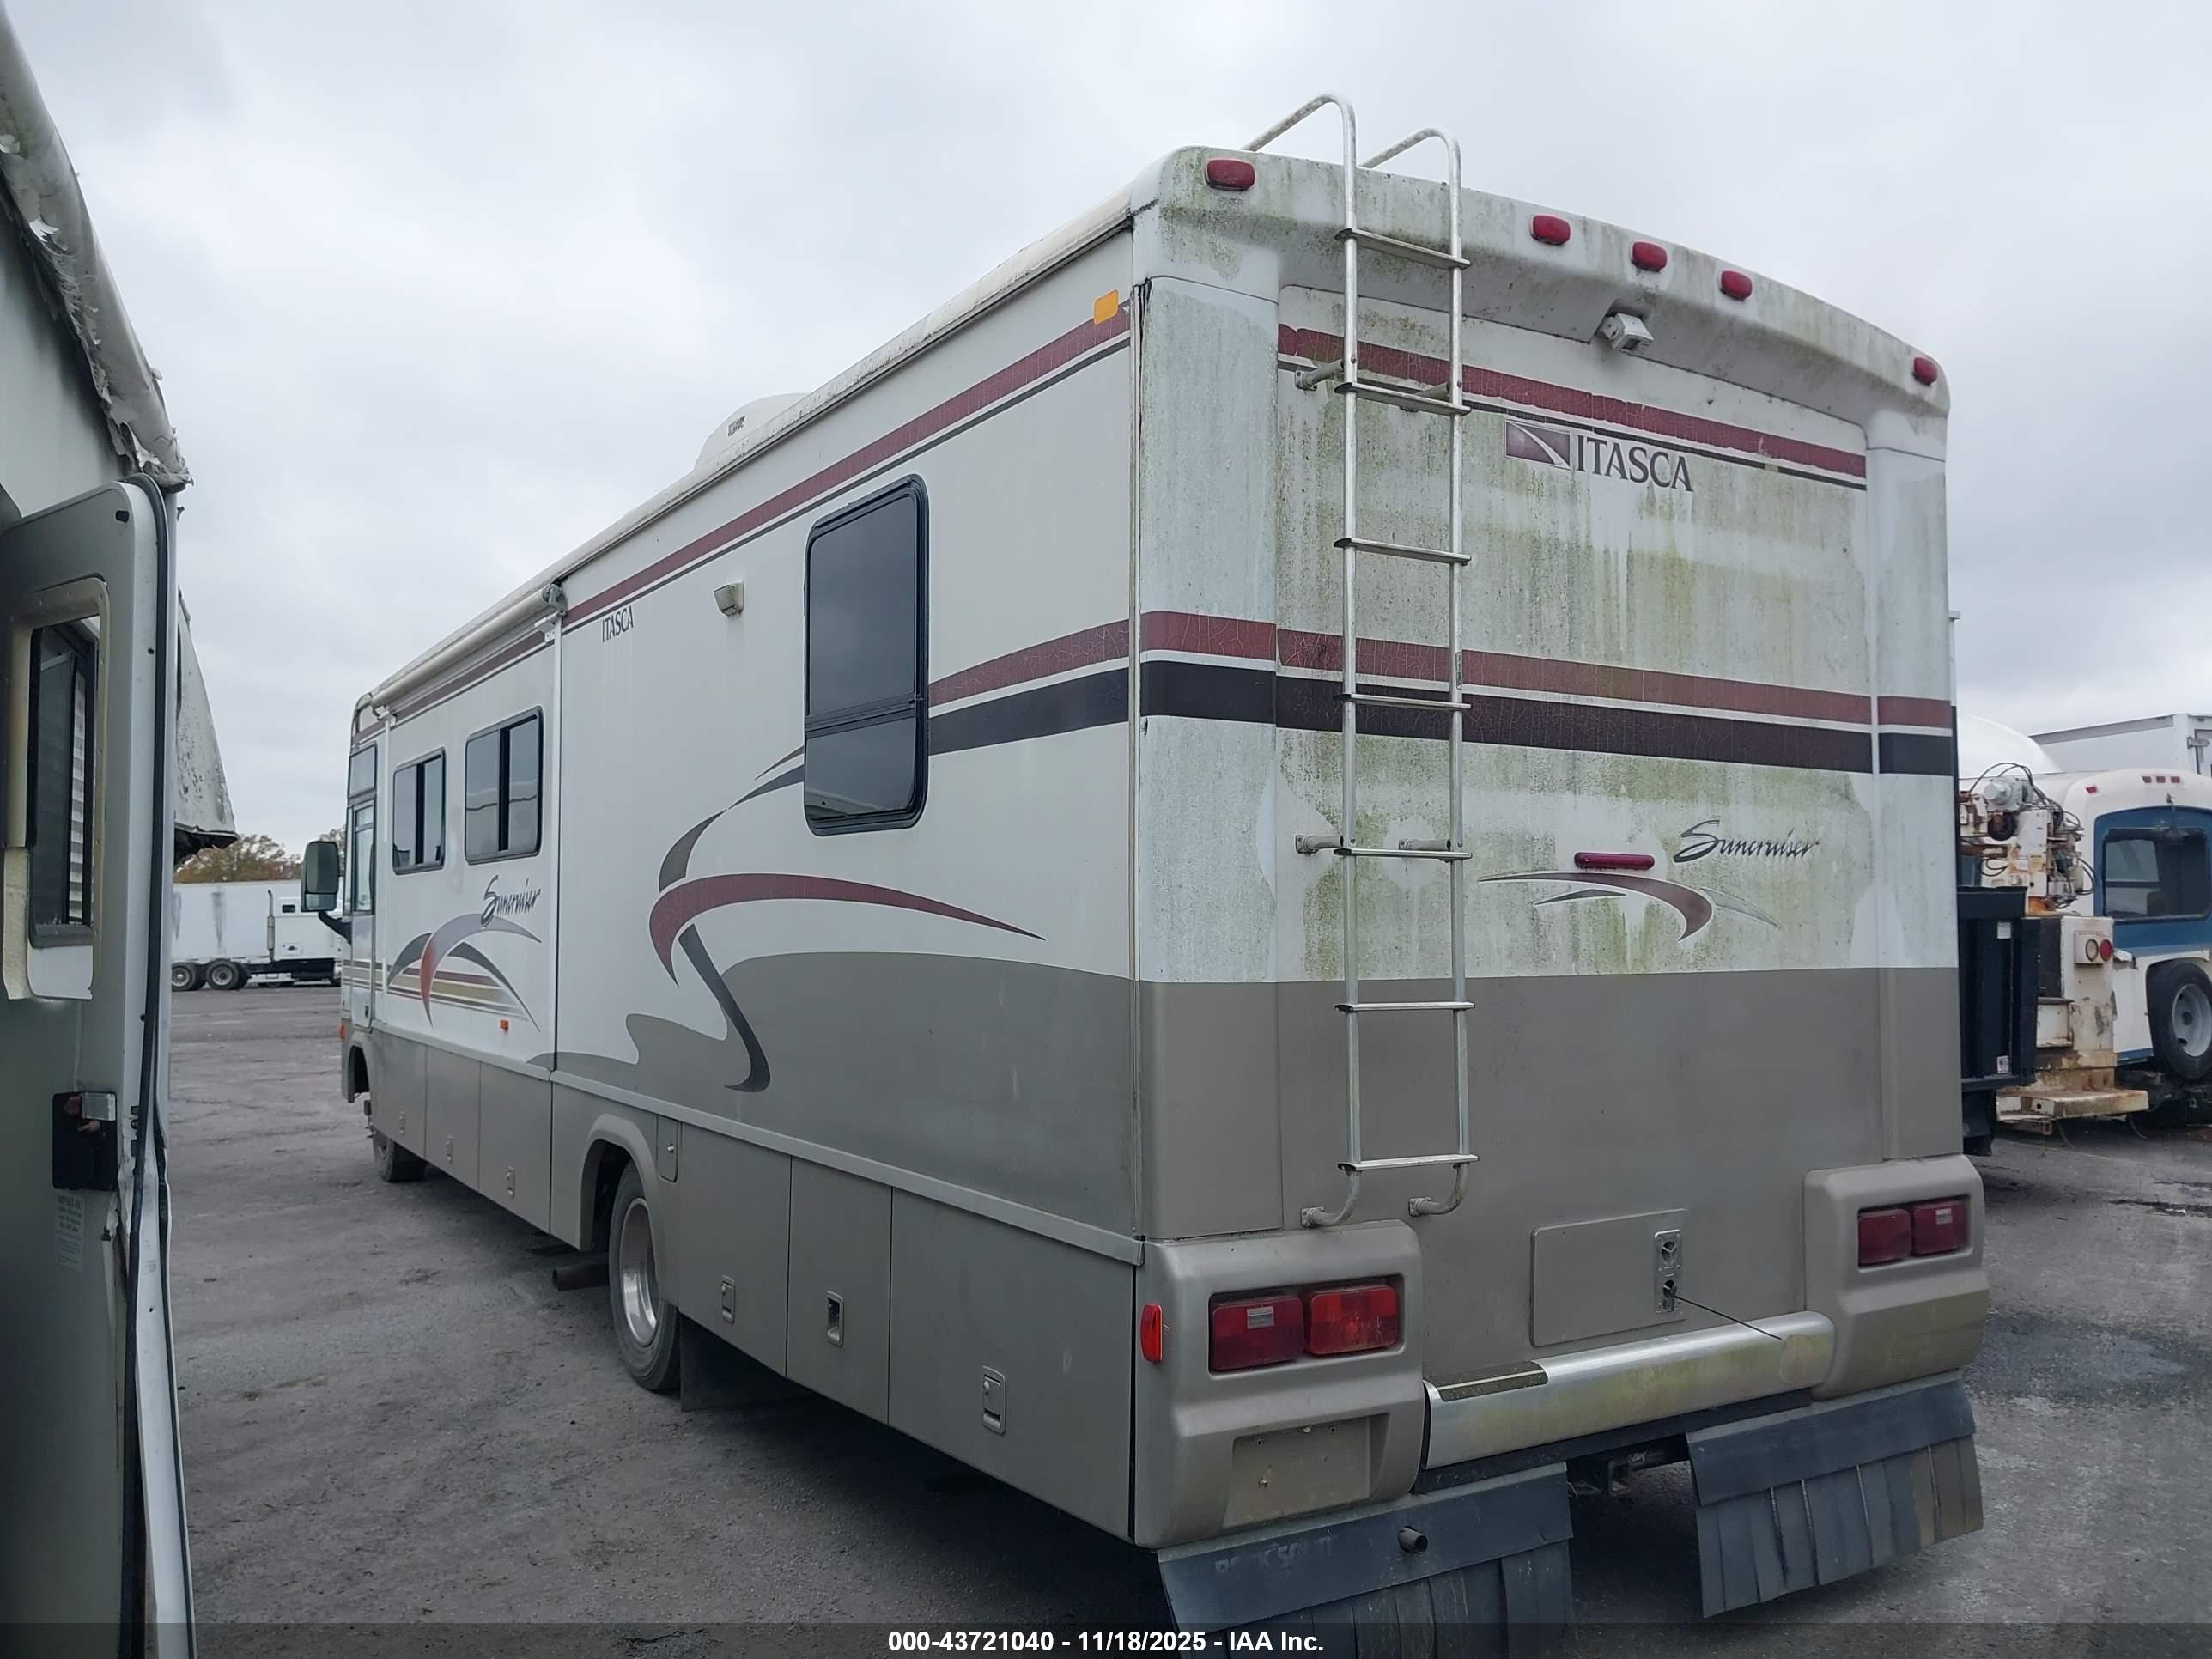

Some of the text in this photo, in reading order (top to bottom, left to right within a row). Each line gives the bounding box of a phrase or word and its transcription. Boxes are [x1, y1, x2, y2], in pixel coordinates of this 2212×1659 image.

[1577, 434, 1693, 491] ITASCA
[602, 605, 634, 642] ITASCA
[1673, 819, 1819, 863] Suncruiser
